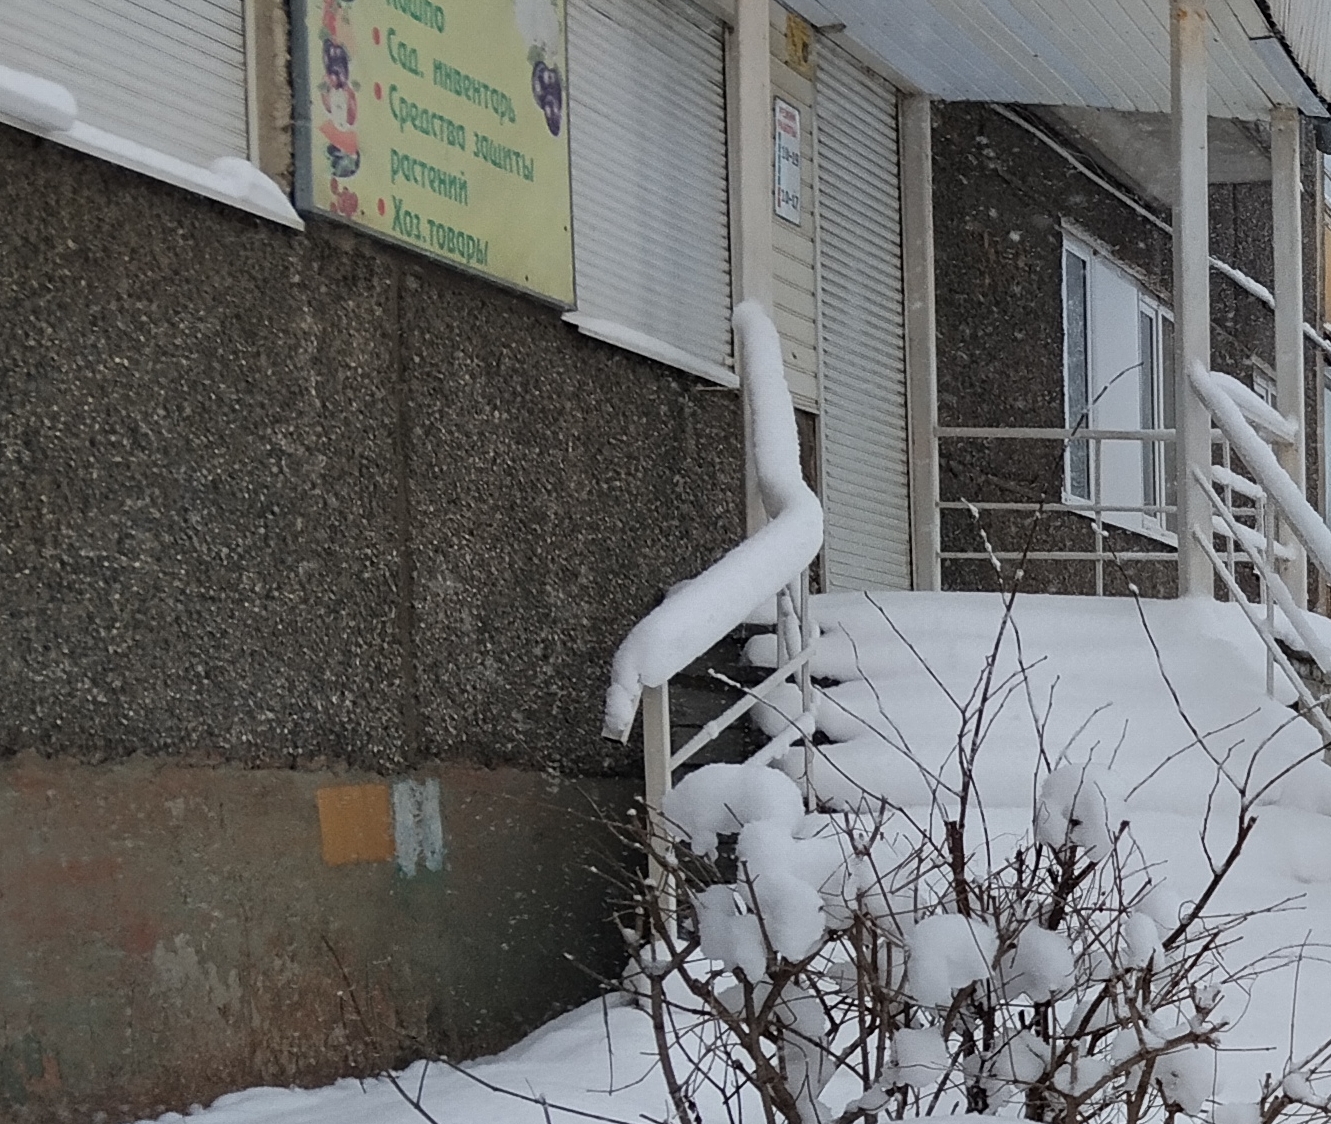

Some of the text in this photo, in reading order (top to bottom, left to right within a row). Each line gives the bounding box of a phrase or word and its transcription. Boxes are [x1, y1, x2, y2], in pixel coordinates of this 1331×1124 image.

[387, 27, 516, 125] Сад. инвентарь
[389, 83, 534, 182] Средства защиты
[390, 147, 468, 206] растений
